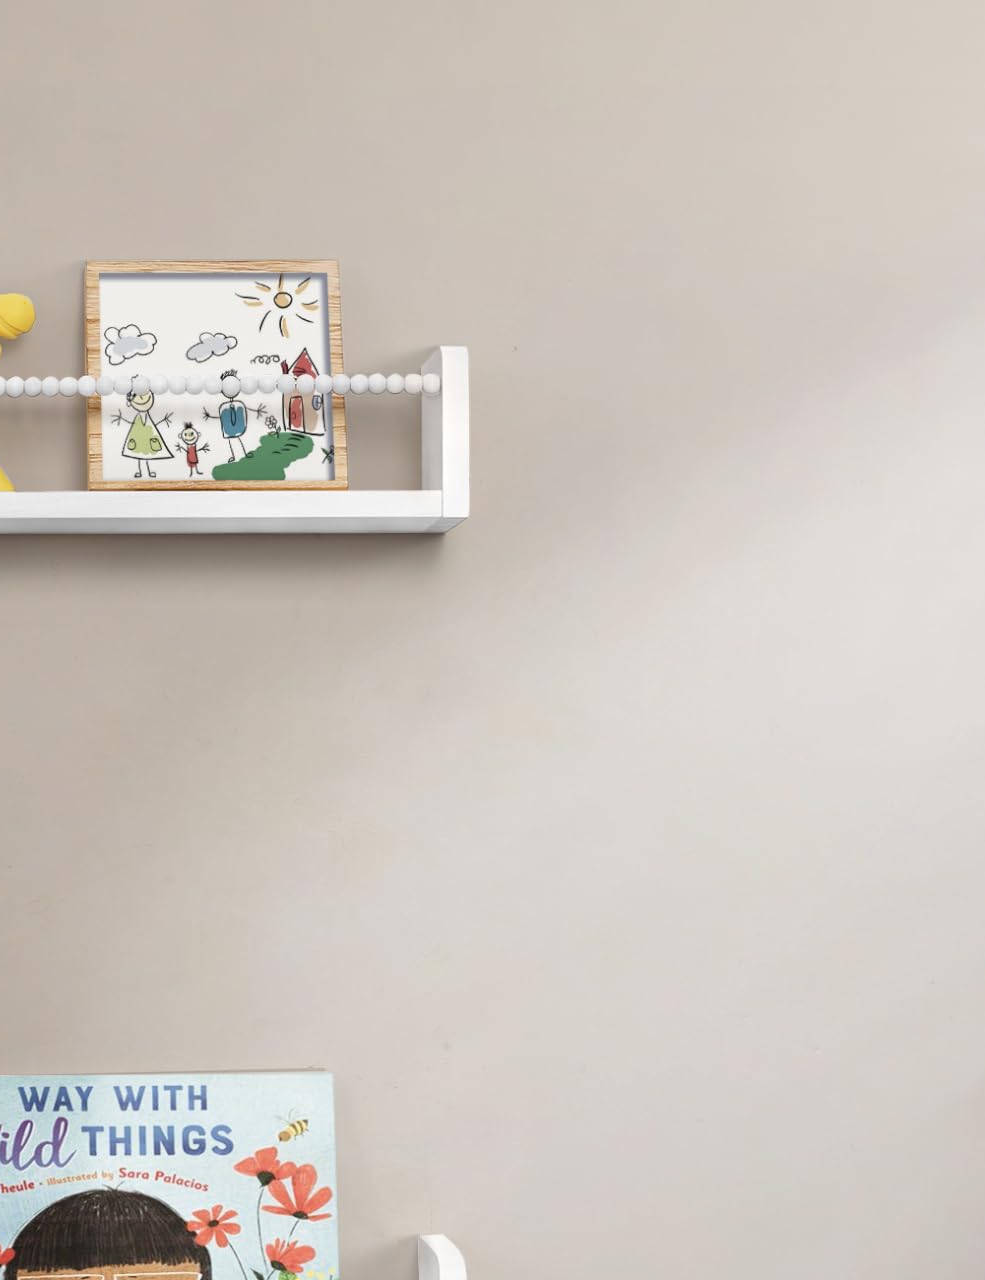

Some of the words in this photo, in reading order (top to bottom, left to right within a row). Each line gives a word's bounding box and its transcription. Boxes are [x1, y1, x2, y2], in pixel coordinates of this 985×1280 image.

[17, 1085, 93, 1112] WAY
[113, 1085, 208, 1111] WITH
[81, 1124, 235, 1156] THINGS
[46, 1171, 98, 1186] illustrated
[102, 1170, 114, 1181] by
[118, 1167, 150, 1181] Sara
[154, 1171, 209, 1193] Palacios
